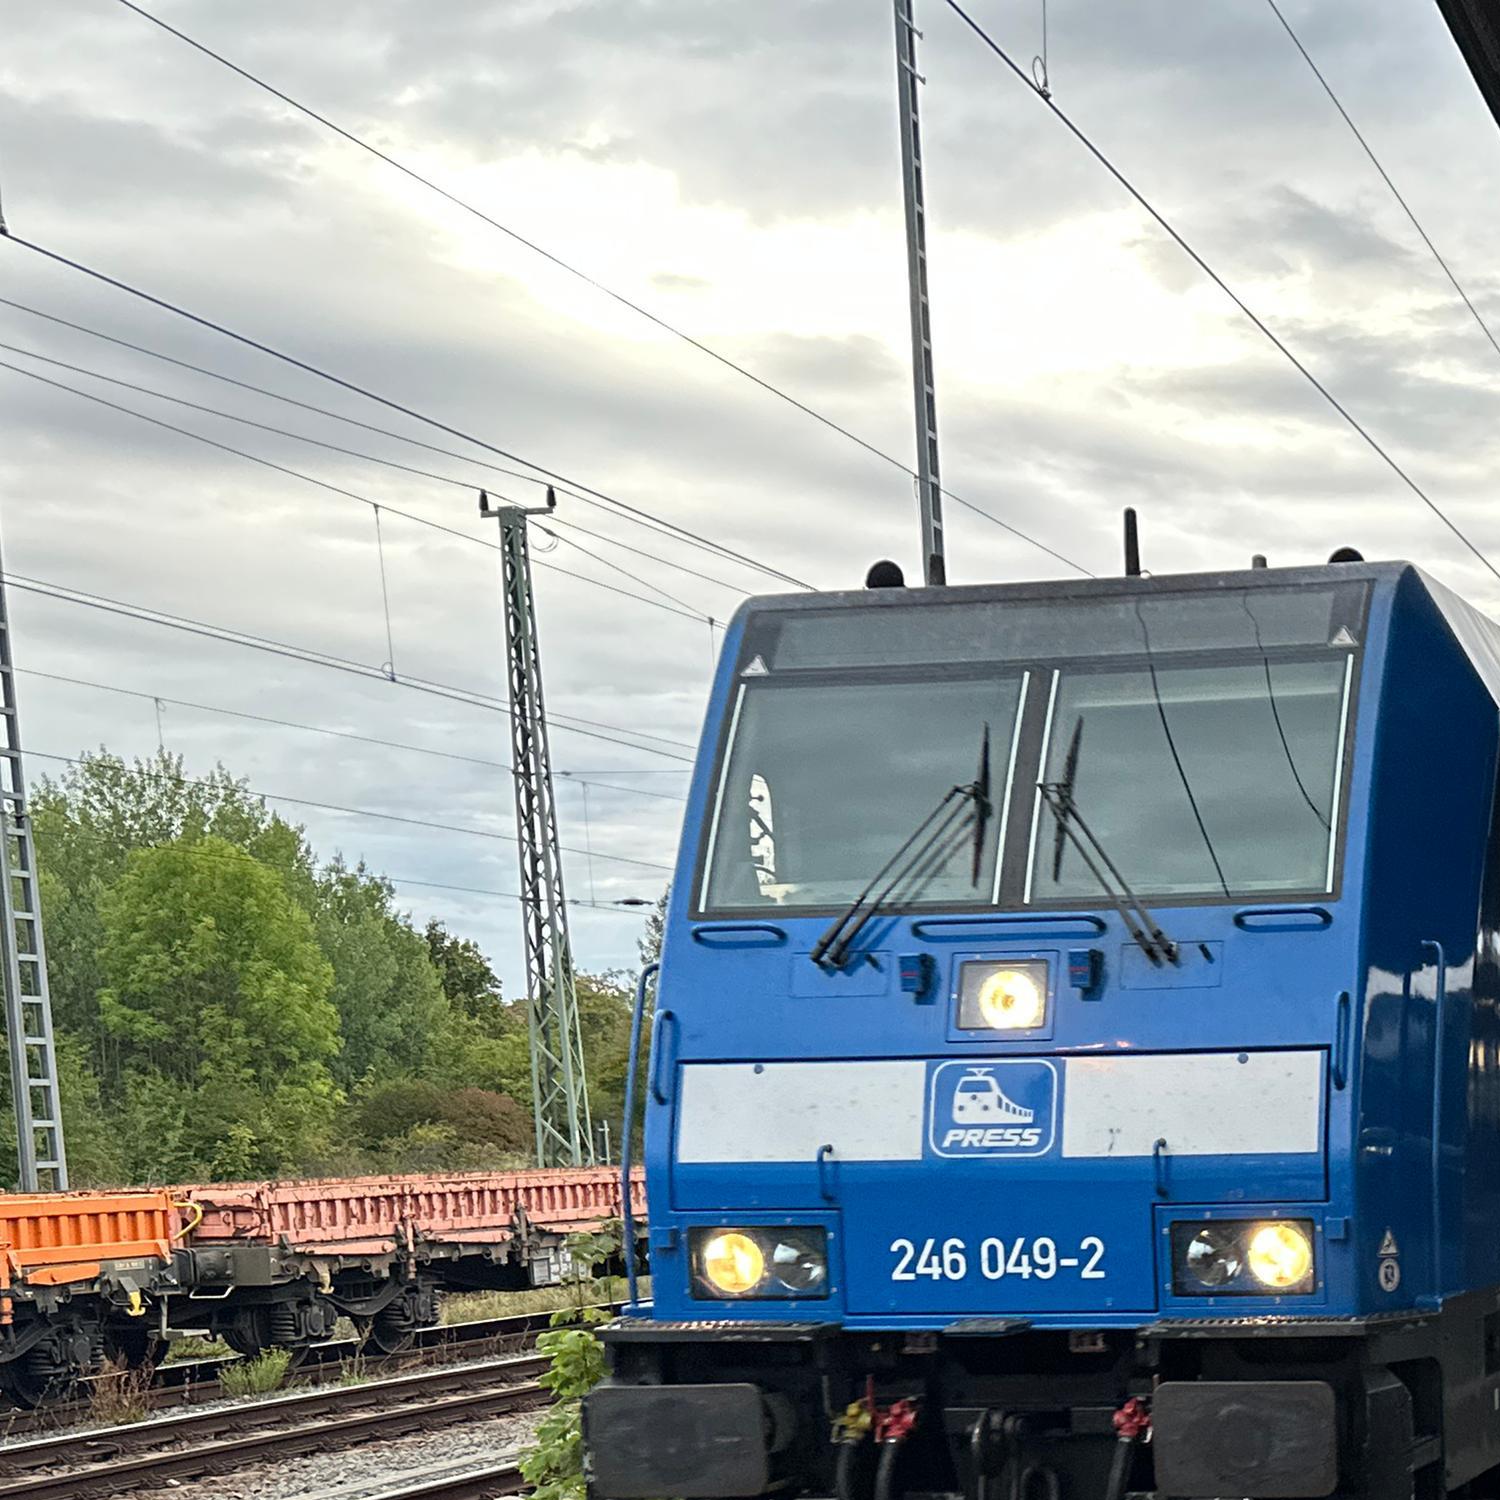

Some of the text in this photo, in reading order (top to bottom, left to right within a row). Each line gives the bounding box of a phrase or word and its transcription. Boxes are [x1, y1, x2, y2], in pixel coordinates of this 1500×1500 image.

[942, 1128, 1043, 1148] PRESS
[890, 1236, 1106, 1281] 246 049-2
